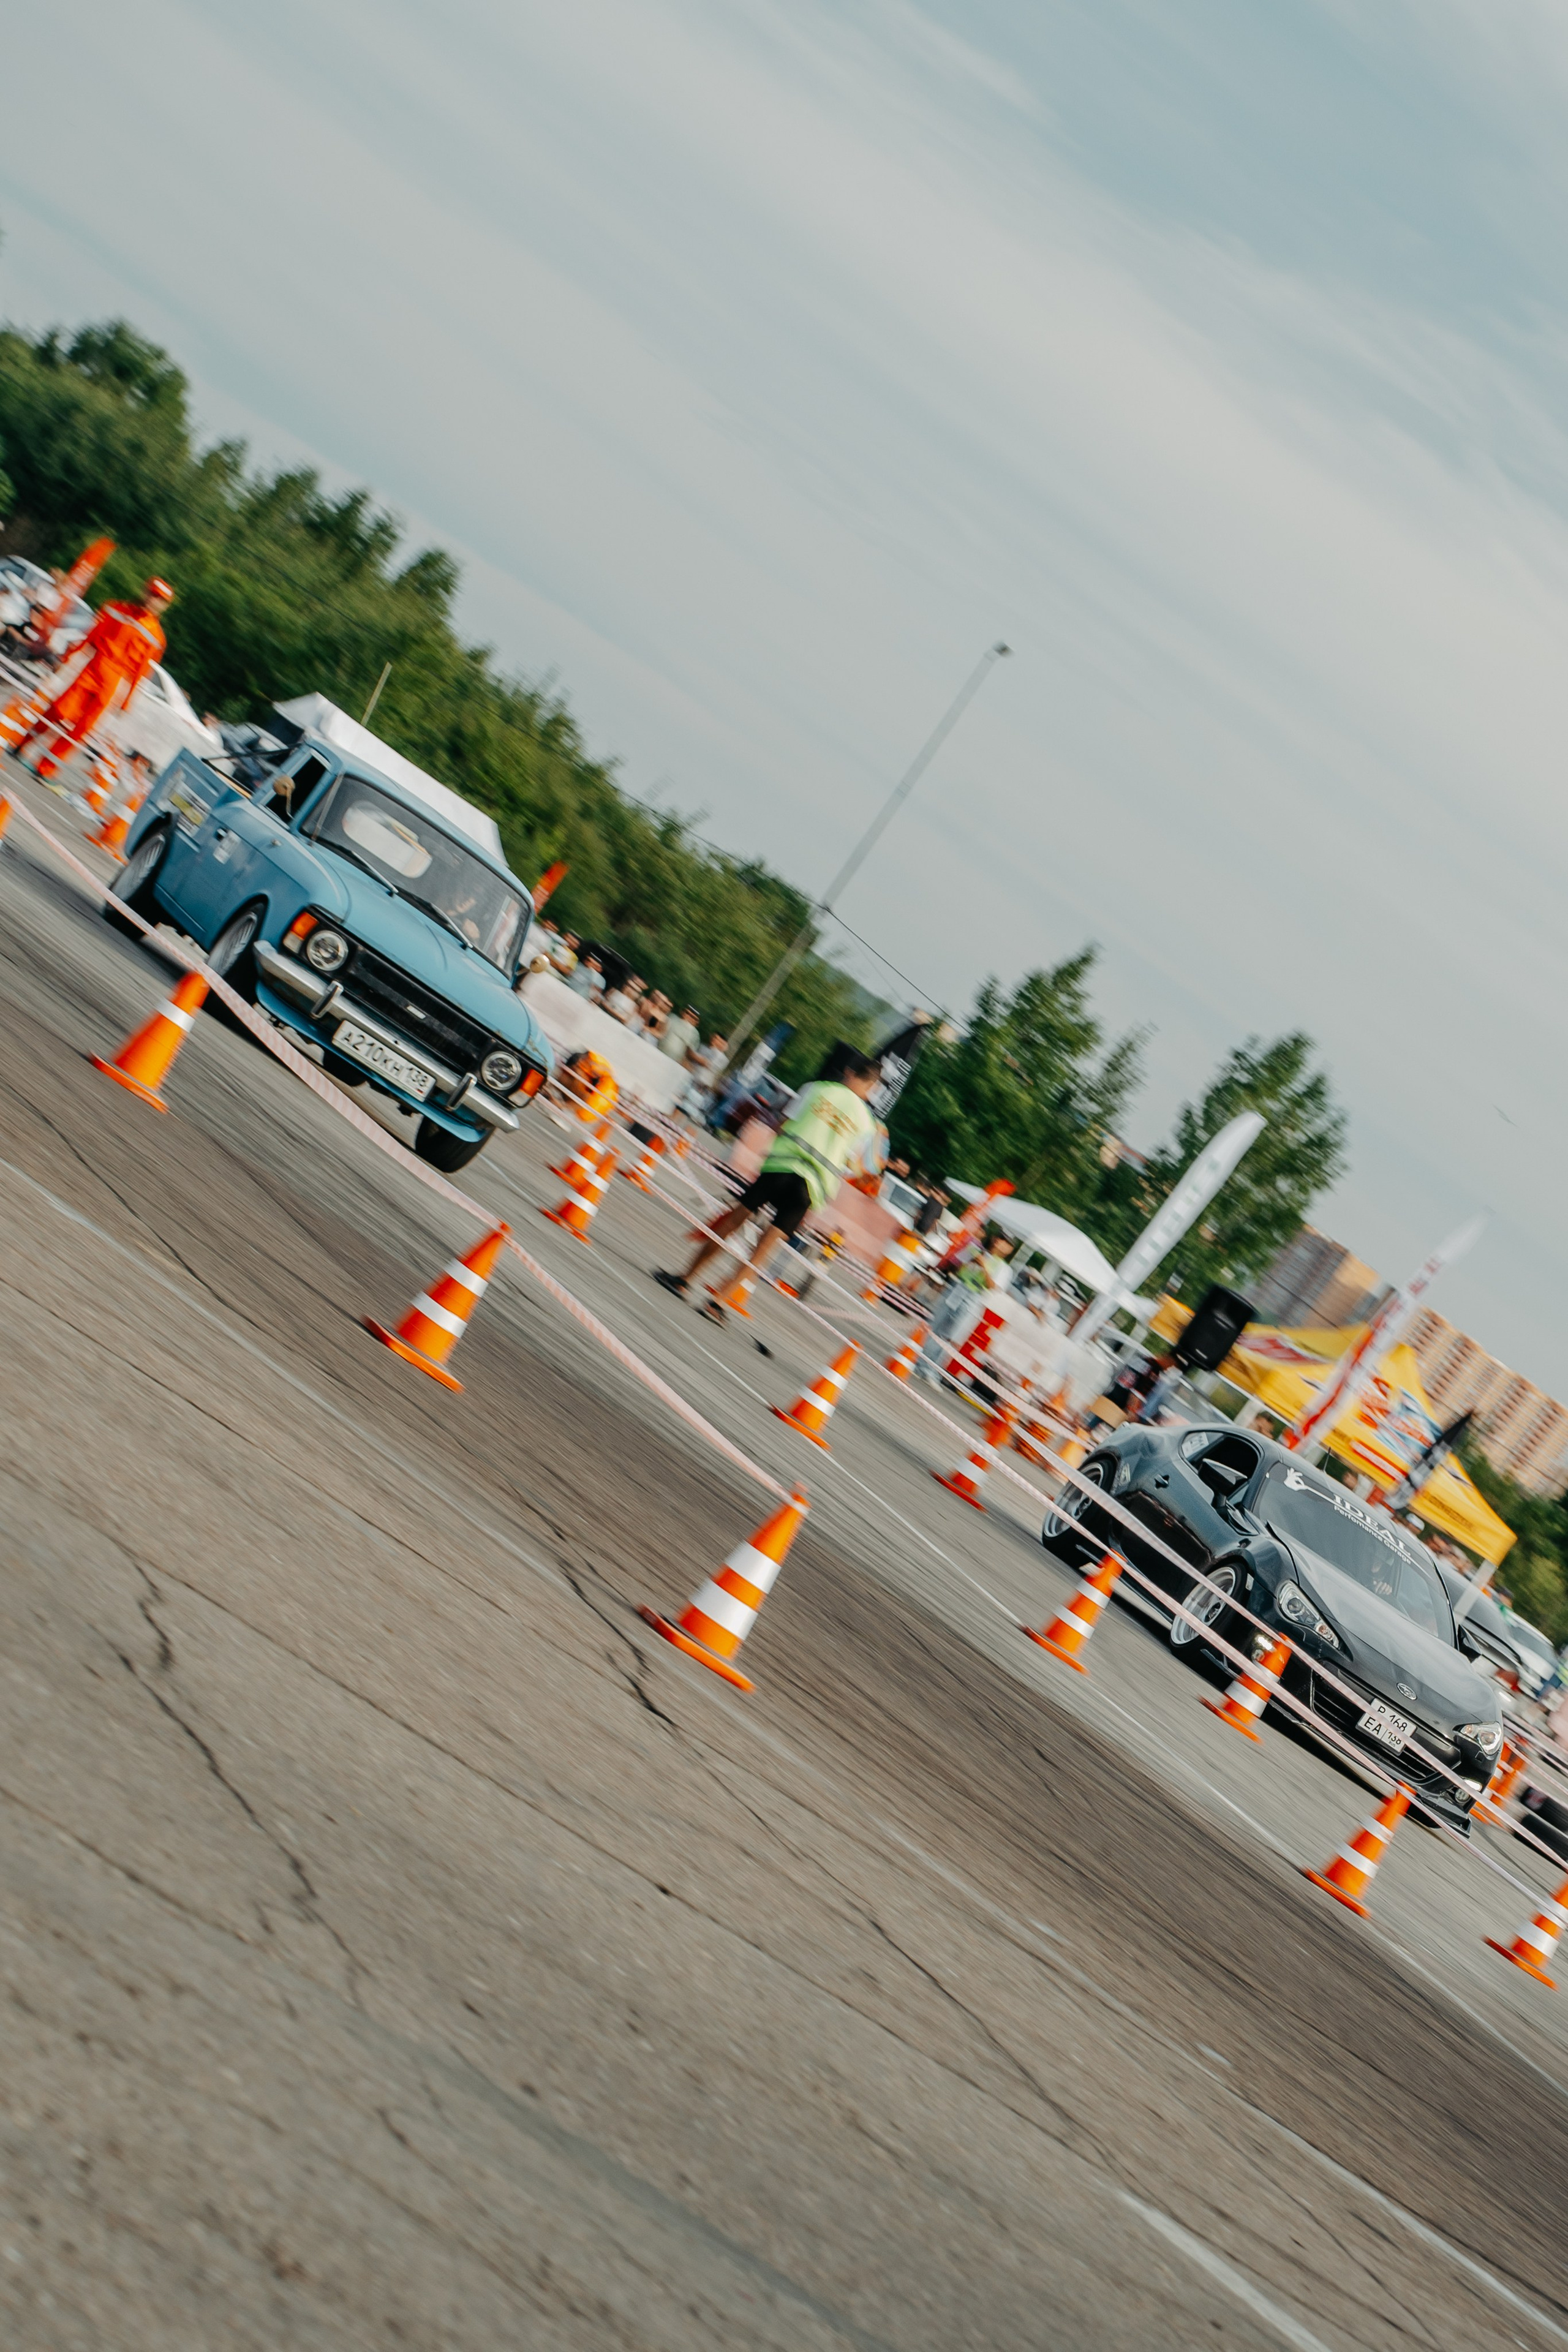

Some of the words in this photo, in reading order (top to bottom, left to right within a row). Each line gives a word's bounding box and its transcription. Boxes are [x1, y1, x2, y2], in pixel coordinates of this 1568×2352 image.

[1333, 1493, 1411, 1556] IDEAL
[1334, 1505, 1383, 1543] Perfomance
[1383, 1539, 1411, 1565] Garage
[1389, 1714, 1408, 1732] 168
